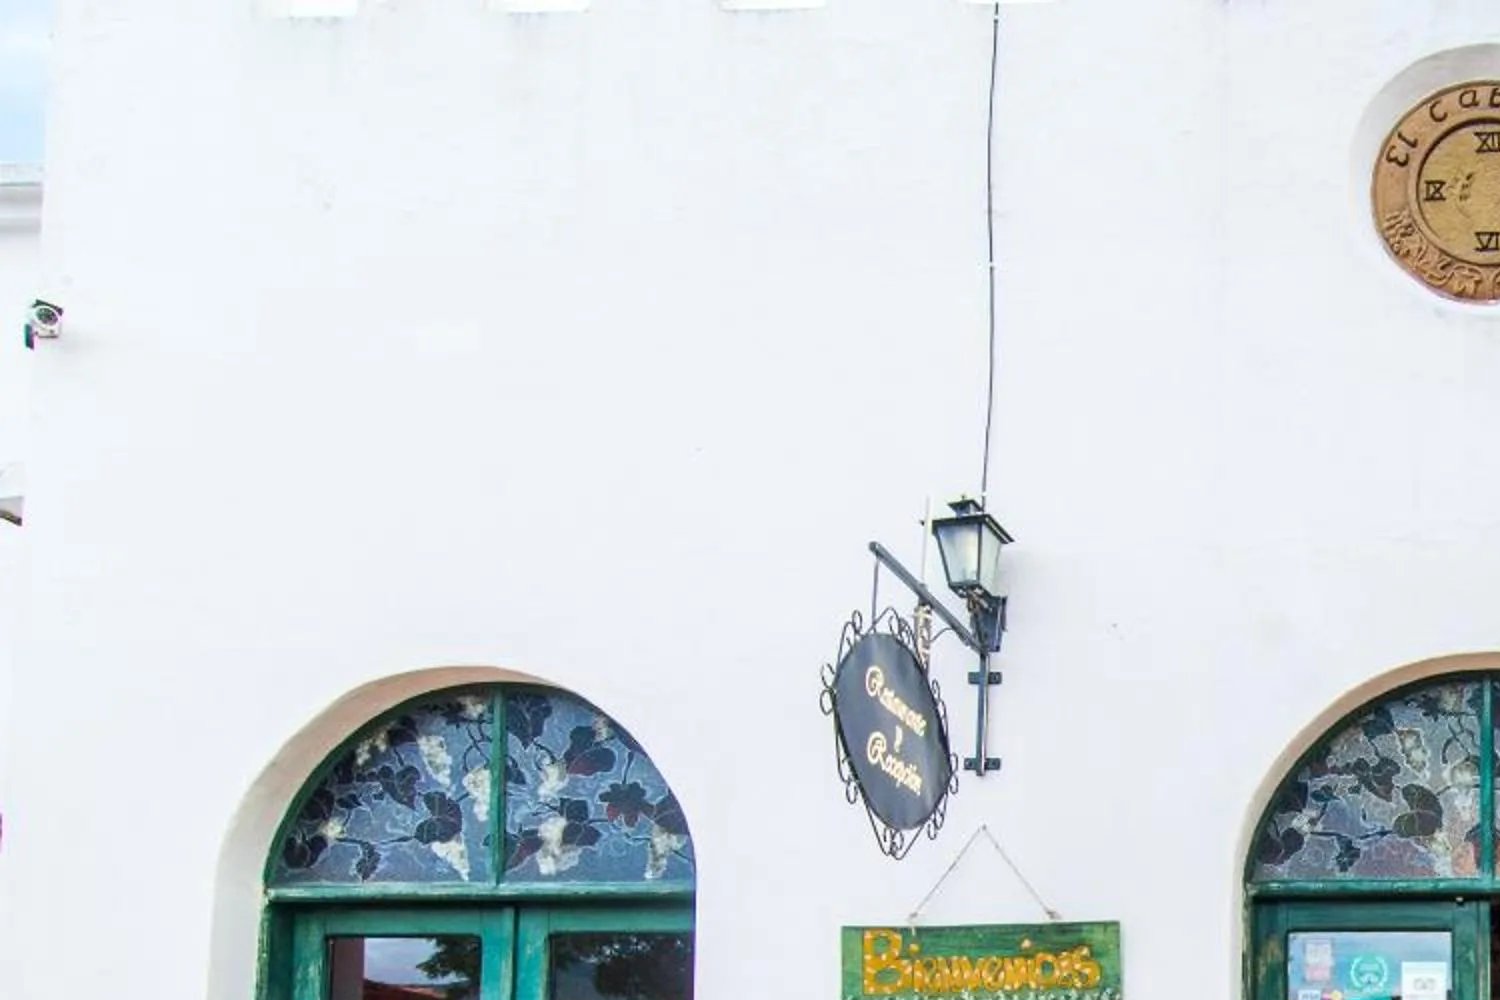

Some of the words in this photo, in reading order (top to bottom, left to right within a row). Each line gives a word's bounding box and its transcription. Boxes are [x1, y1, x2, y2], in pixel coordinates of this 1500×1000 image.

[1385, 131, 1418, 168] El
[1423, 180, 1446, 201] IX
[1475, 232, 1500, 251] VI
